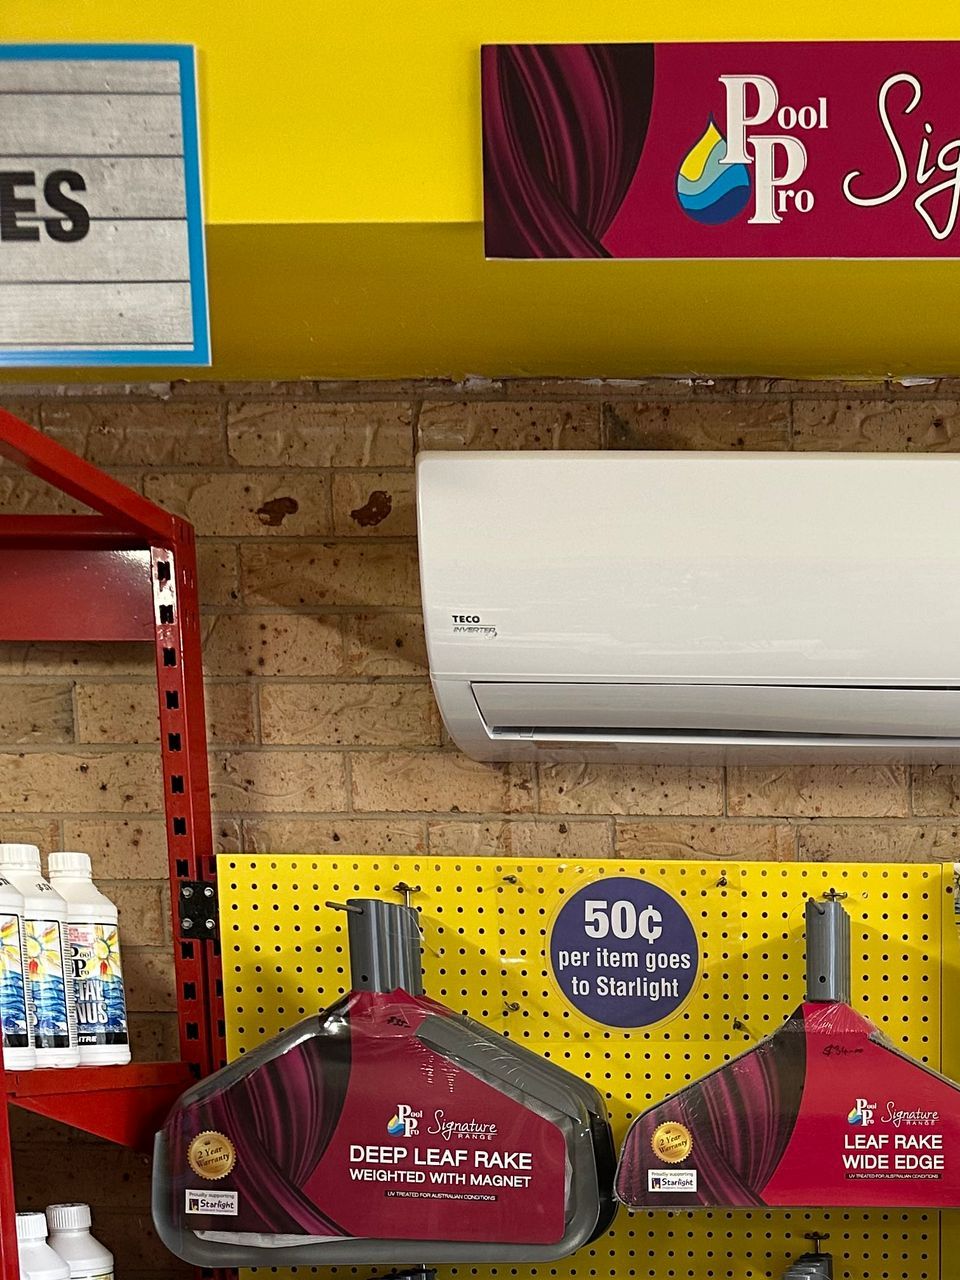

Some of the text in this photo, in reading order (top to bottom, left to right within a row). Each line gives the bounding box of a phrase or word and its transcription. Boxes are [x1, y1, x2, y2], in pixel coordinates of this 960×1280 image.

[719, 74, 828, 164] Pool
[747, 135, 815, 225] Pro
[451, 615, 480, 624] TECO
[583, 899, 662, 943] 50¢
[558, 946, 690, 972] per item goes
[571, 976, 680, 1000] to Starlight
[427, 1109, 497, 1141] Signature
[881, 1102, 939, 1128] Signature
[844, 1134, 943, 1149] LEAF RAKE
[350, 1145, 533, 1170] DEEP LEAF RAKE
[842, 1154, 945, 1170] WIDE EDGE
[350, 1168, 532, 1188] WEIGHTED WITH MAGNET
[662, 1178, 694, 1187] Starlight
